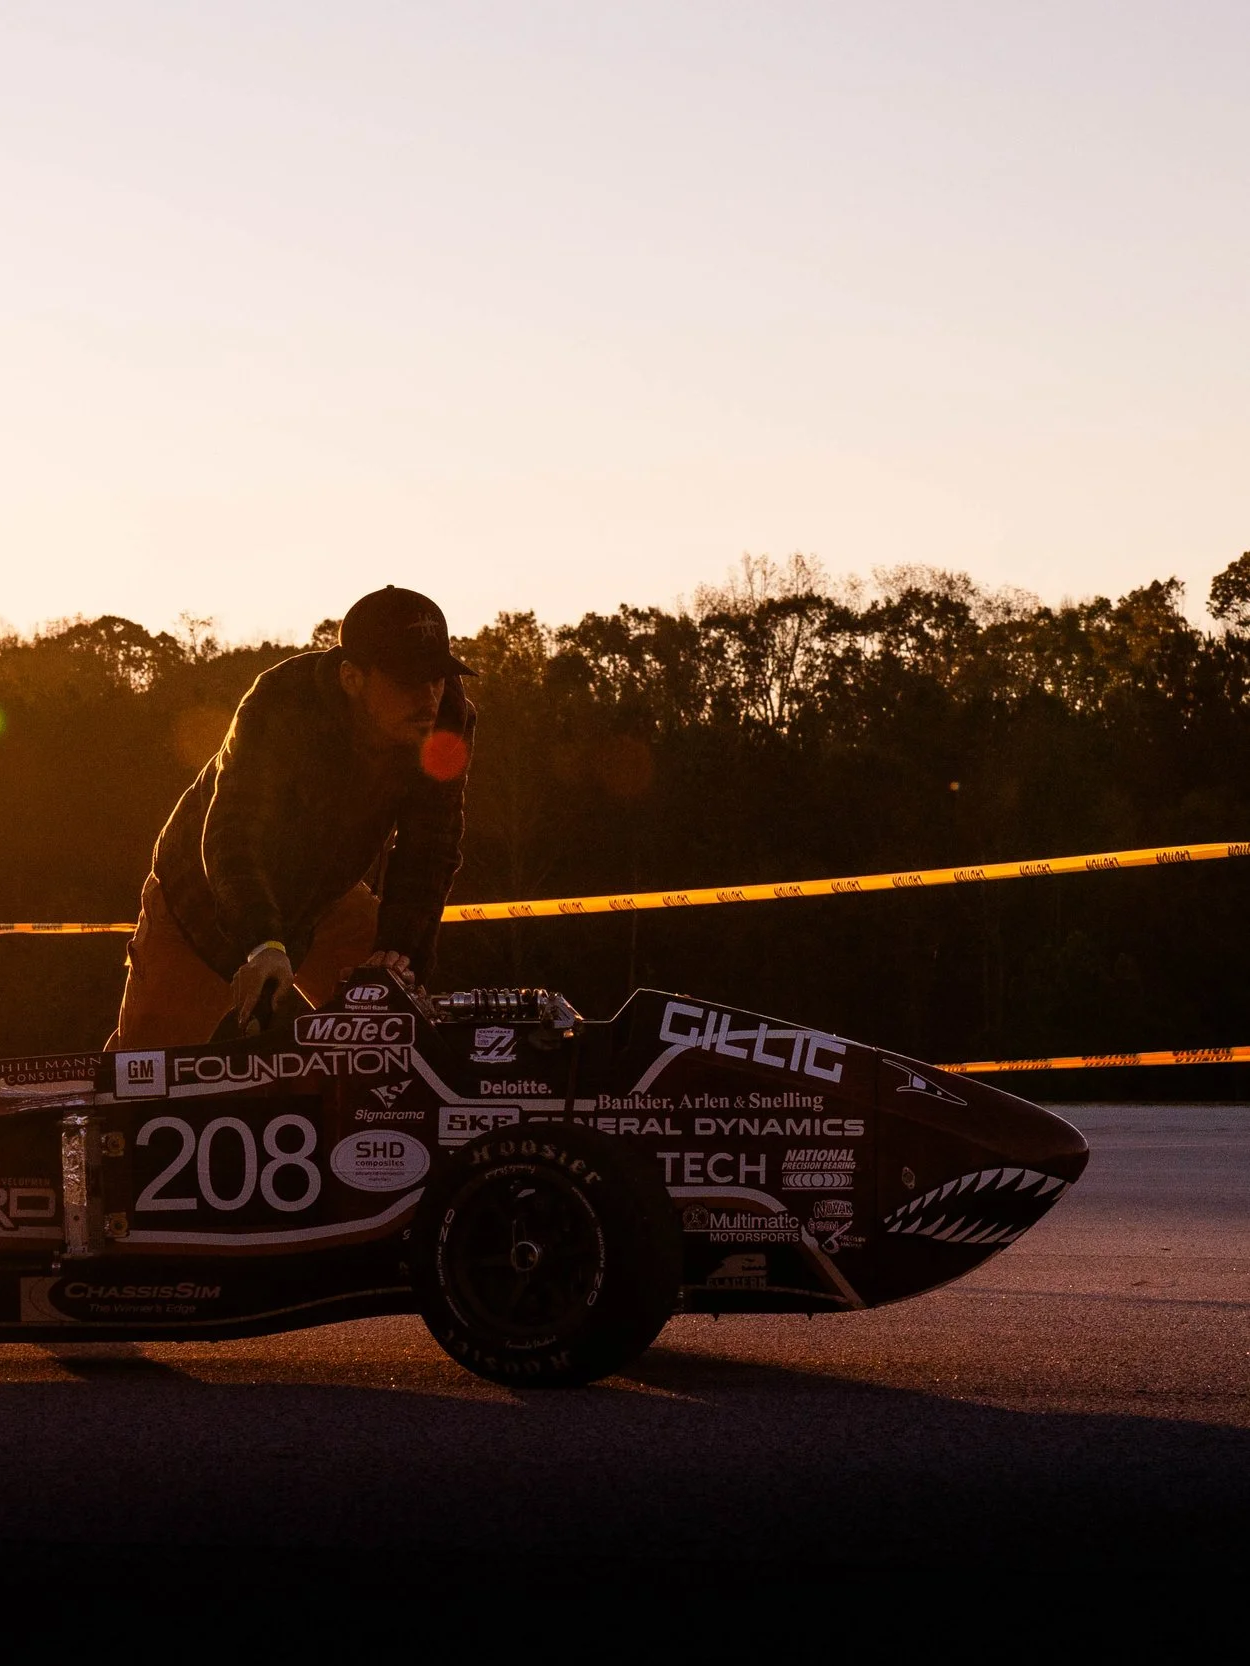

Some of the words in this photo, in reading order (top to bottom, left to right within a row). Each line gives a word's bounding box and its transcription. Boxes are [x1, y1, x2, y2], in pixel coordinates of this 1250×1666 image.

[352, 986, 382, 1001] IR
[305, 1017, 403, 1042] MoTeC
[658, 1001, 847, 1084] GILLIG
[1, 1057, 102, 1073] HILLMANN
[127, 1059, 154, 1079] GM
[174, 1046, 411, 1082] FOUNDATION
[7, 1067, 96, 1084] CONSULTING
[480, 1080, 552, 1095] Deloitte.
[598, 1093, 675, 1112] Bankier,
[678, 1093, 729, 1109] Arlen
[733, 1096, 747, 1109] &
[749, 1092, 824, 1112] Snelling
[355, 1109, 426, 1122] Signarama
[448, 1115, 513, 1131] SKF
[695, 1118, 865, 1136] DYNAMICS
[356, 1141, 405, 1158] SHD
[784, 1149, 855, 1162] NATIONAL
[135, 1113, 321, 1212] 208
[355, 1160, 405, 1168] composites
[656, 1152, 767, 1185] TECH
[781, 1161, 822, 1170] PRECISION
[823, 1161, 856, 1170] BEARING
[710, 1212, 799, 1229] Multimatic
[710, 1232, 800, 1243] MOTORSPORTS
